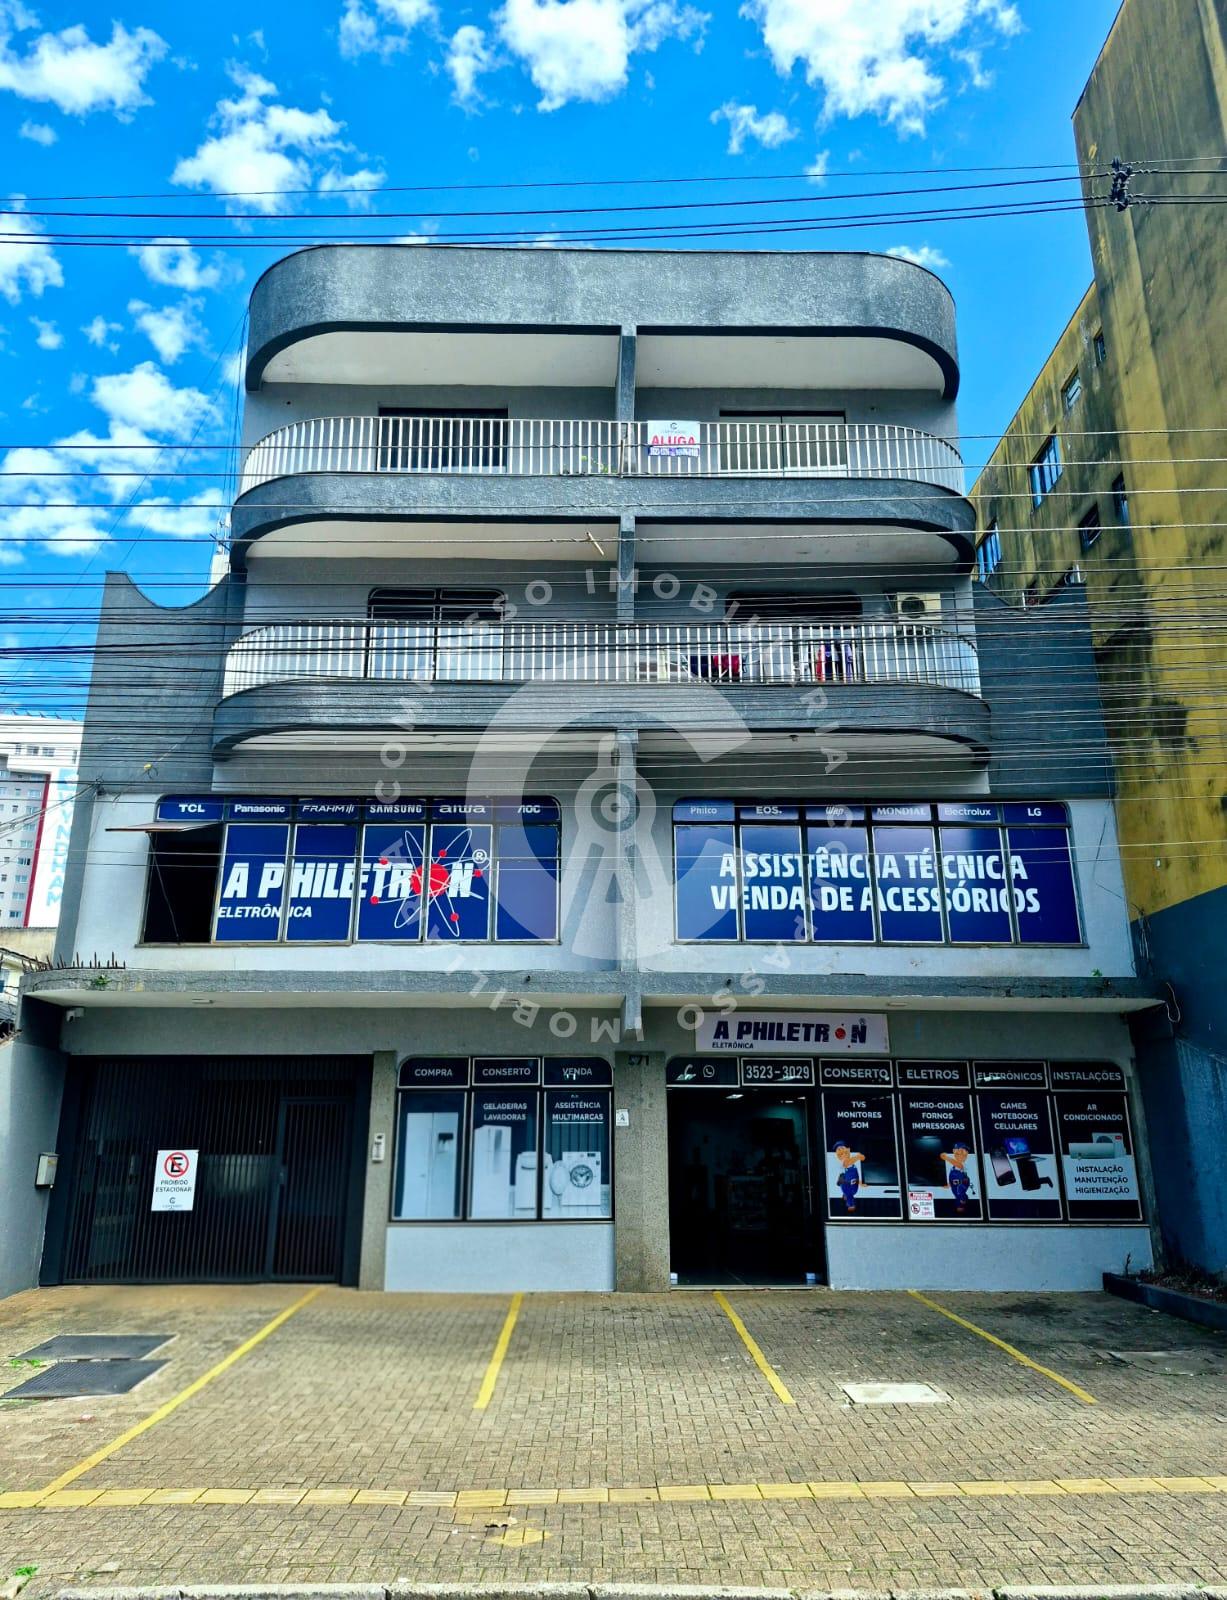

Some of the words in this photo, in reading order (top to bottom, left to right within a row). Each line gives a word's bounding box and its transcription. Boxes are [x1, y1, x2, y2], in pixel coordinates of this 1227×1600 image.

[651, 435, 696, 445] ALUGA
[179, 804, 205, 813] TCL
[234, 804, 286, 813] Panasonic
[302, 805, 347, 813] FRAHM
[370, 805, 422, 813] SAMSUNG
[439, 805, 486, 813] aiwa
[876, 807, 926, 816] MONDIAL
[944, 808, 992, 816] Electrolux
[1027, 808, 1042, 817] LG
[719, 846, 900, 879] ASSISTÊNCIA
[904, 847, 1029, 880] TÉCNICA
[222, 862, 250, 899] A
[710, 885, 815, 911] VENDA
[821, 886, 854, 912] DE
[860, 880, 1041, 913] ACESSÓRIOS
[218, 903, 313, 918] ELETRÔNICA
[713, 1020, 730, 1040] A
[414, 1068, 453, 1077] COMPRA
[482, 1068, 531, 1076] CONSERTO
[562, 1067, 593, 1076] VENDA
[746, 1065, 810, 1080] 3523-3029
[824, 1068, 888, 1078] CONSERTO
[906, 1069, 959, 1080] ELETROS
[1053, 1071, 1122, 1082] INSTALAÇÕES
[555, 1101, 601, 1109] ASSISTÊNCIA
[484, 1113, 527, 1121] LAVADORAS
[552, 1113, 604, 1121] MULTIMARCAS
[851, 1121, 869, 1129] SOM
[912, 1122, 965, 1130] IMPRESSORAS
[1076, 1165, 1124, 1173] INSTALAÇÃO
[1074, 1176, 1129, 1184] MANUTENÇÃO
[1075, 1186, 1130, 1195] HIGIENIZAÇÃO
